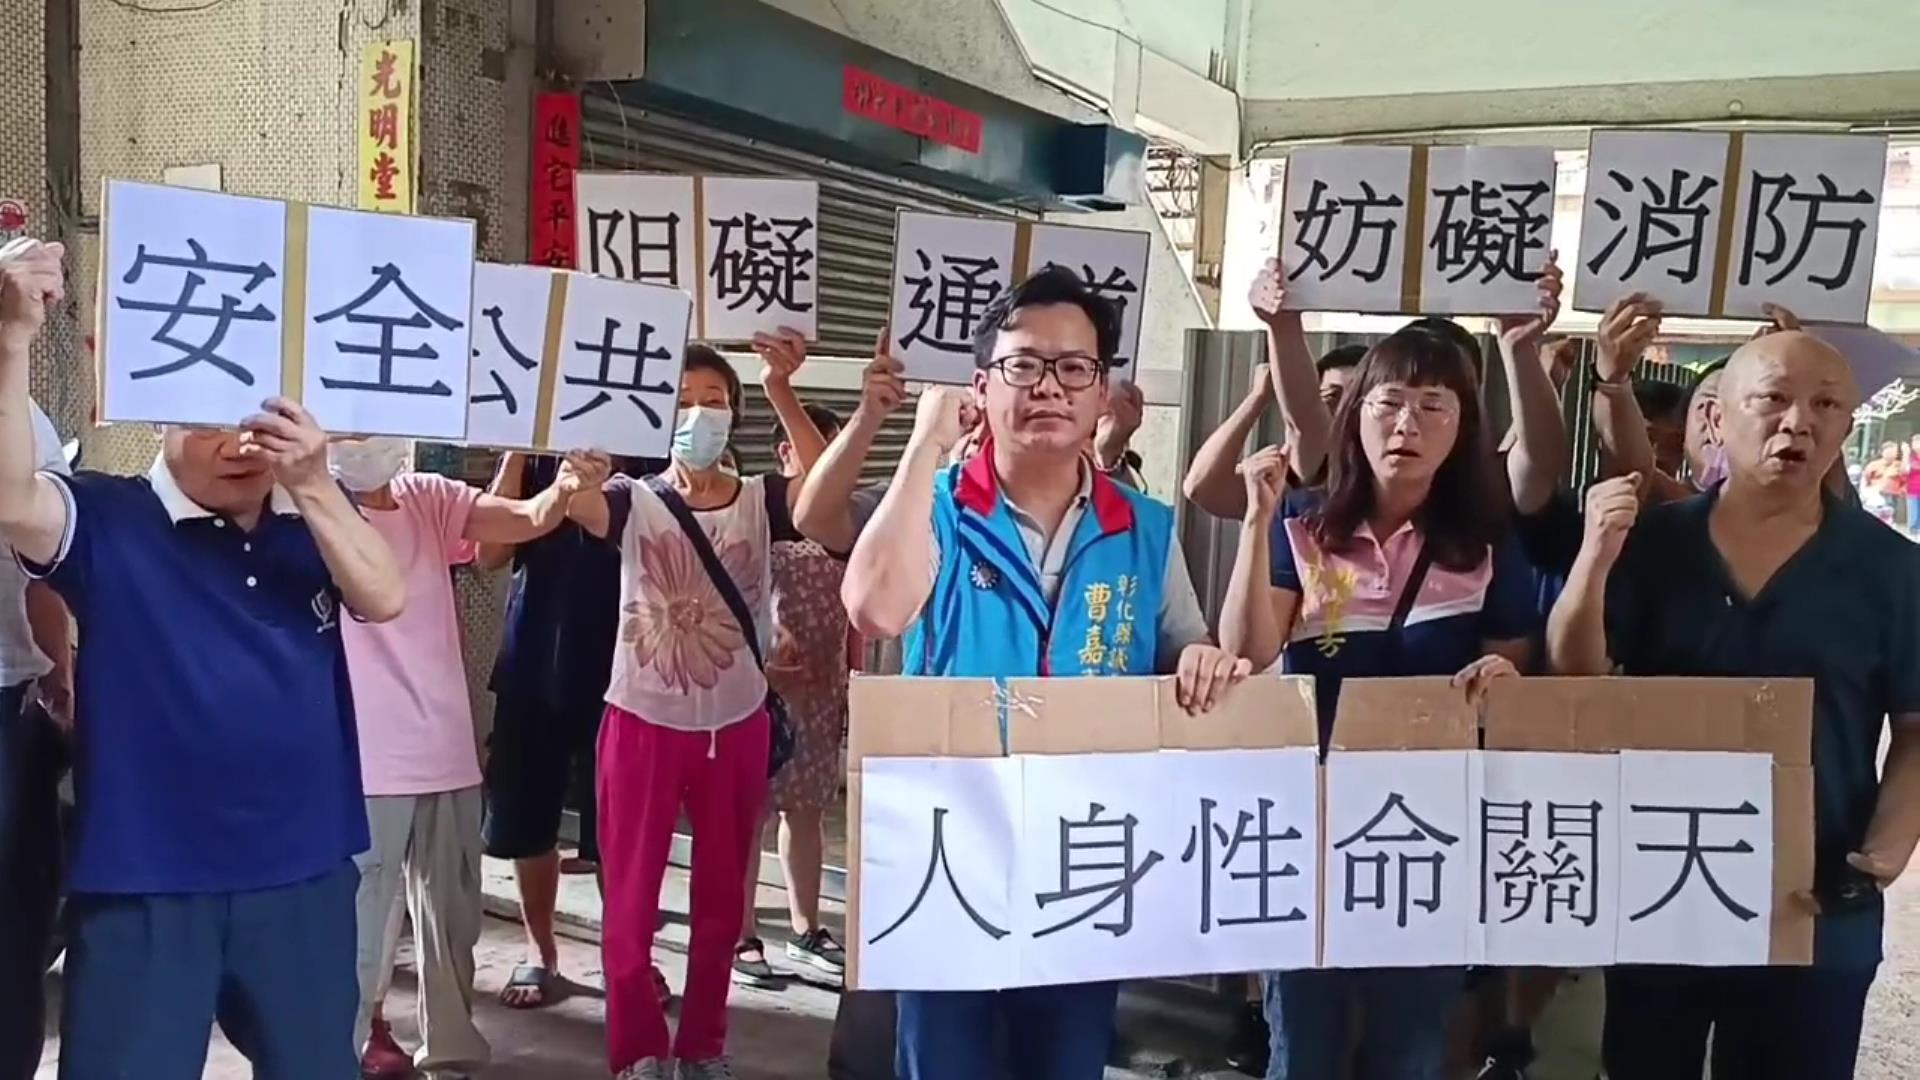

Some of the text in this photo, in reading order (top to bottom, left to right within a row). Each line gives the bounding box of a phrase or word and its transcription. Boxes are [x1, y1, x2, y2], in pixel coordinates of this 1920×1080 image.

[369, 50, 401, 210] 光明堂
[587, 207, 814, 313] 阻礙
[1288, 180, 1551, 284] 妨礙
[1587, 168, 1875, 290] 消防
[116, 238, 464, 399] 安全
[1078, 581, 1112, 675] 曹嘉
[1108, 574, 1138, 675] 彰化縣議
[868, 791, 1761, 944] 人身性命關天
